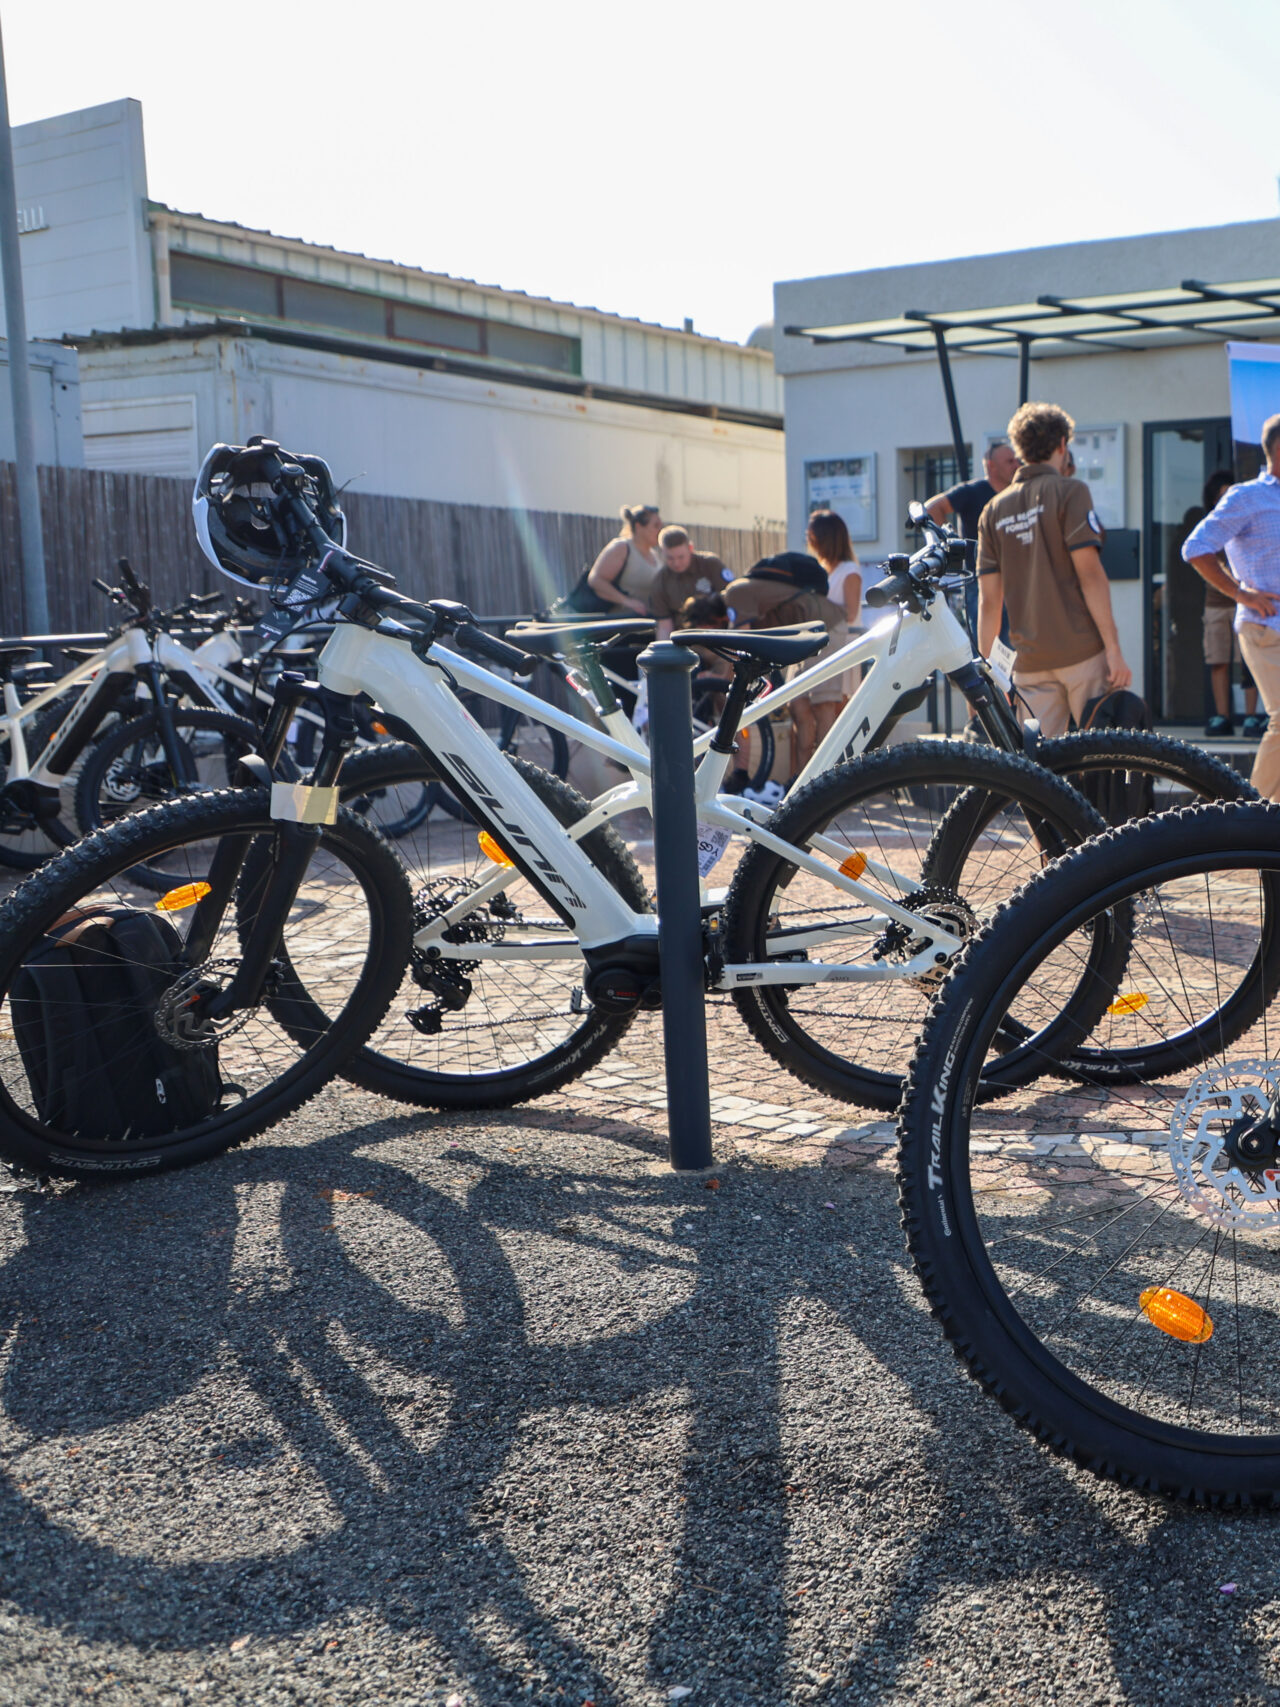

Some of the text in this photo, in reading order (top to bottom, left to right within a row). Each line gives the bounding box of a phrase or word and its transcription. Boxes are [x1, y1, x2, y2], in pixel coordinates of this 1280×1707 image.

[1082, 753, 1188, 775] CONTINENTAL
[441, 751, 588, 910] SUNN
[48, 1154, 161, 1170] CONTINENTAL
